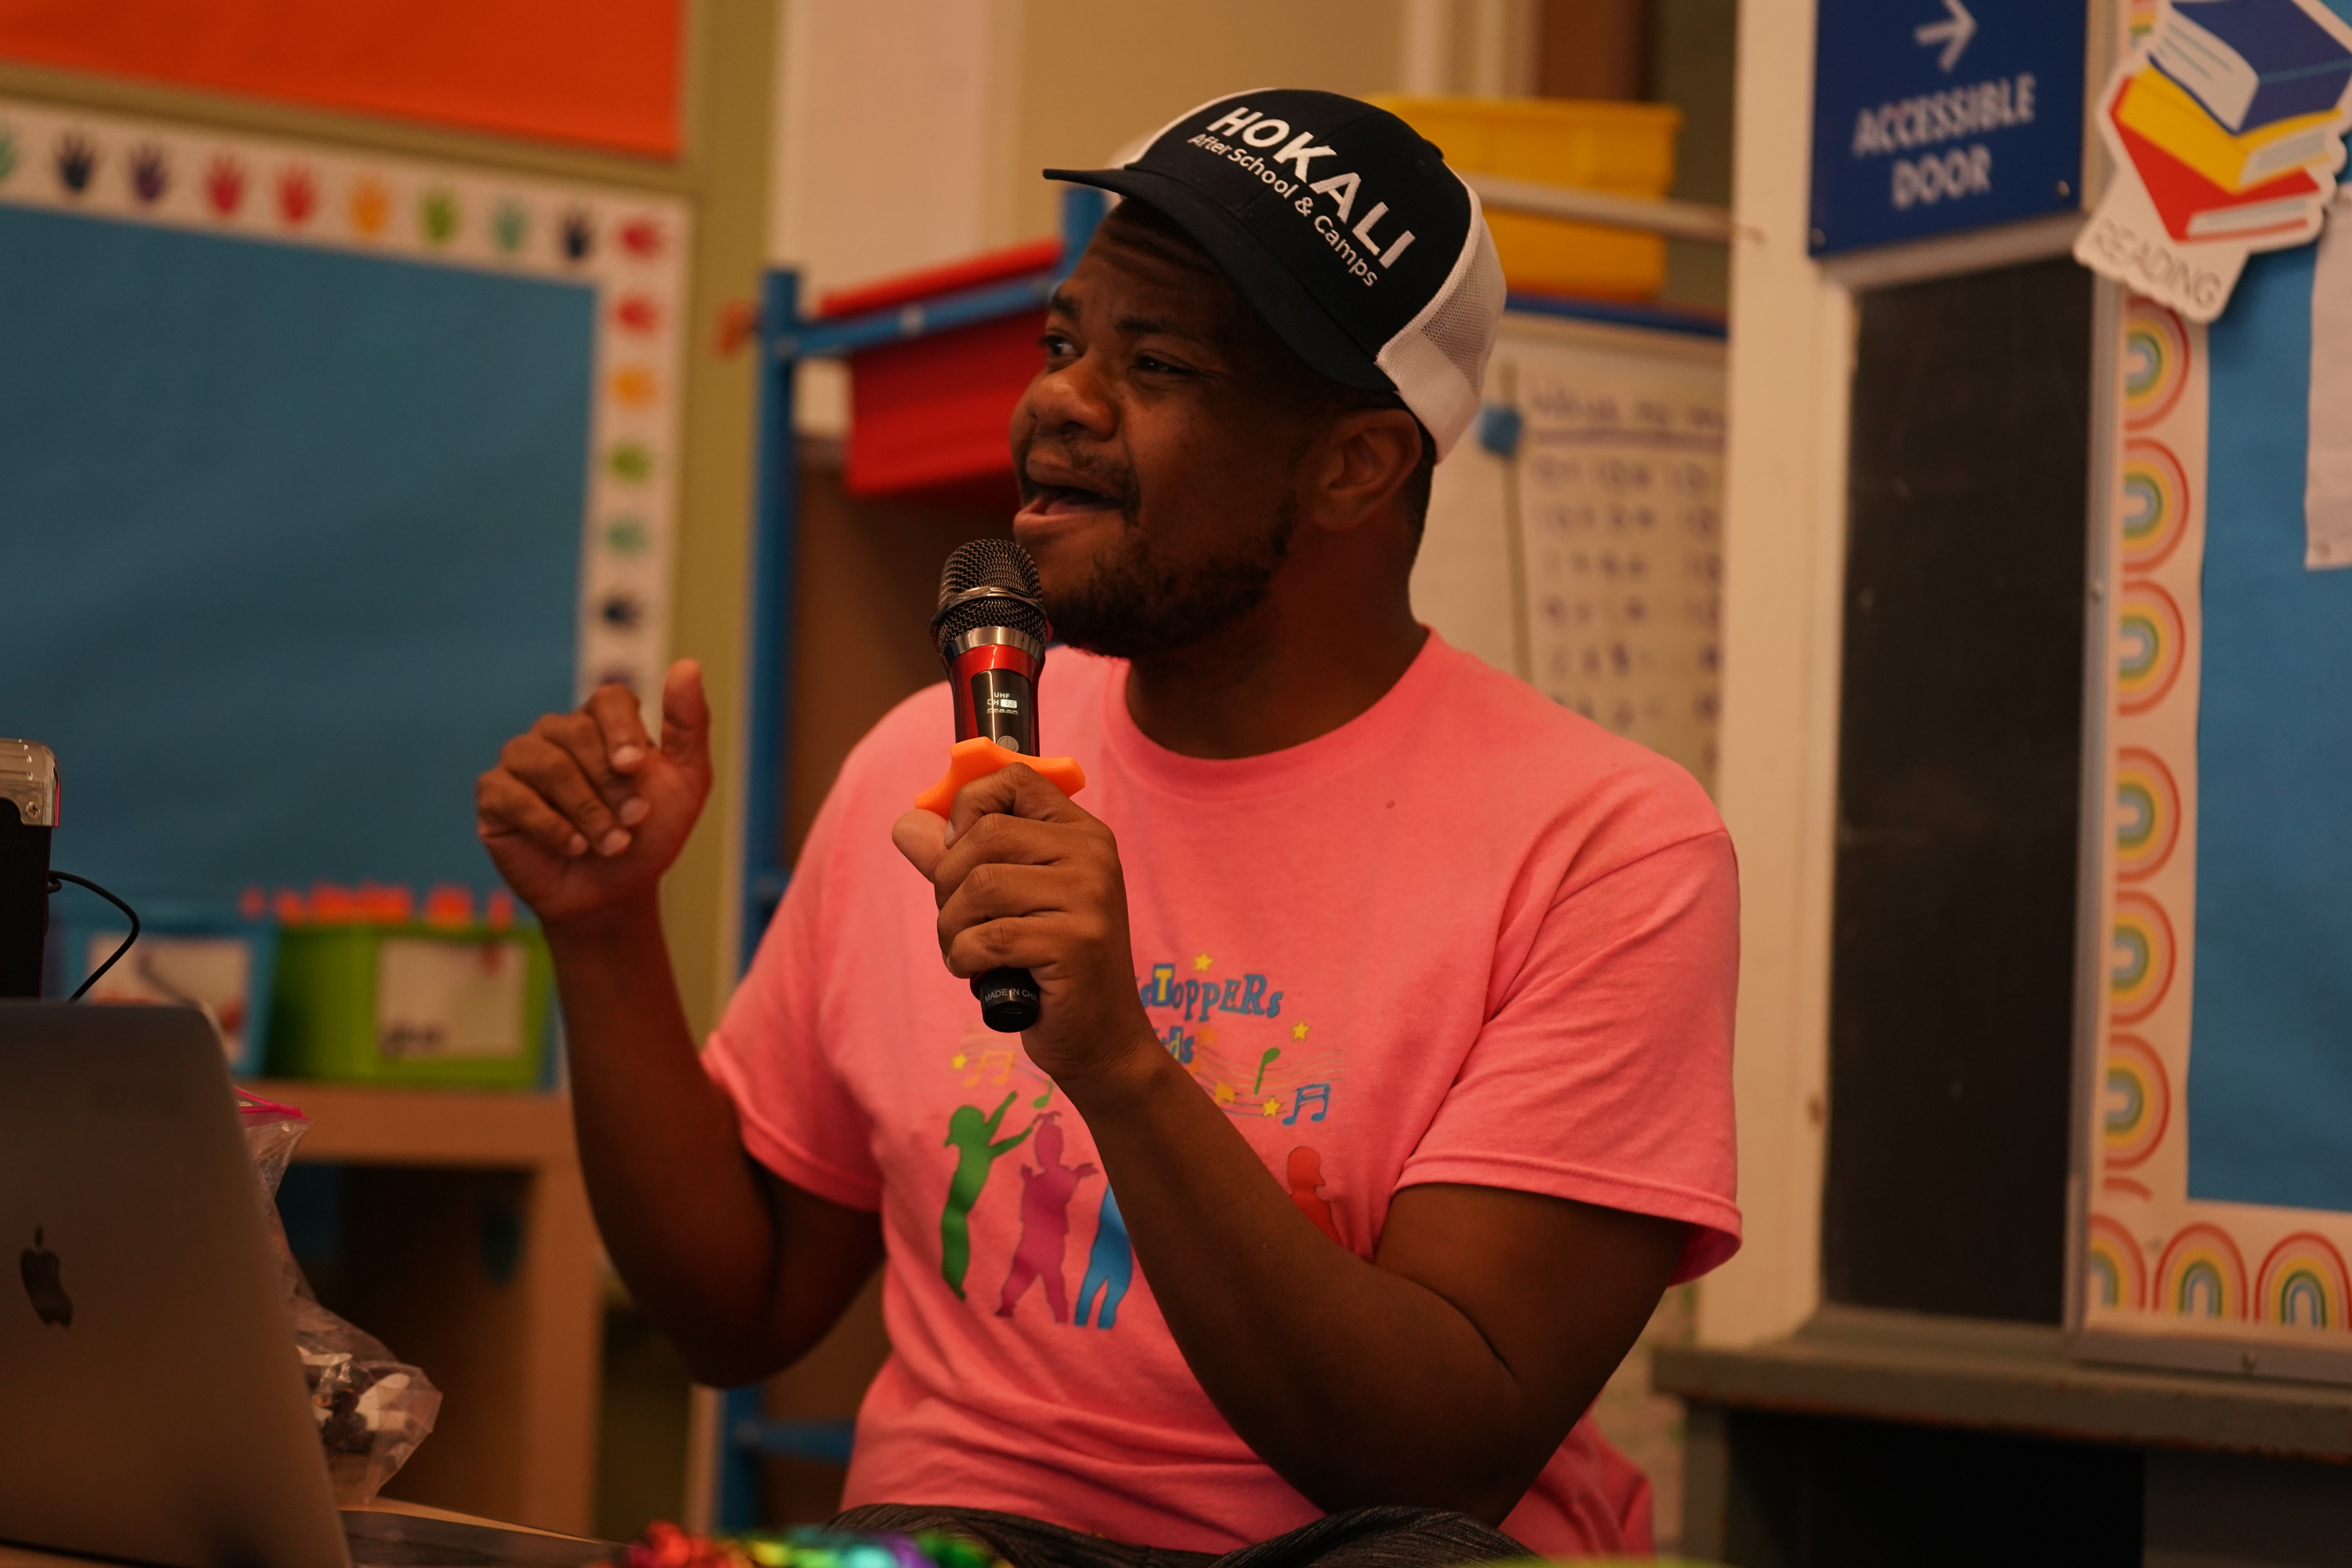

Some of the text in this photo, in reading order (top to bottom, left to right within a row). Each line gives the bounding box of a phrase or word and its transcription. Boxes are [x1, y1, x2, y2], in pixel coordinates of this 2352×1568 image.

[1852, 72, 2036, 159] ACCESSIBLE
[1187, 133, 1378, 287] After School & Camps
[1206, 107, 1416, 269] HOKALI
[1891, 143, 1992, 211] DOOR
[2094, 216, 2221, 310] READING
[985, 988, 1007, 1003] MADE
